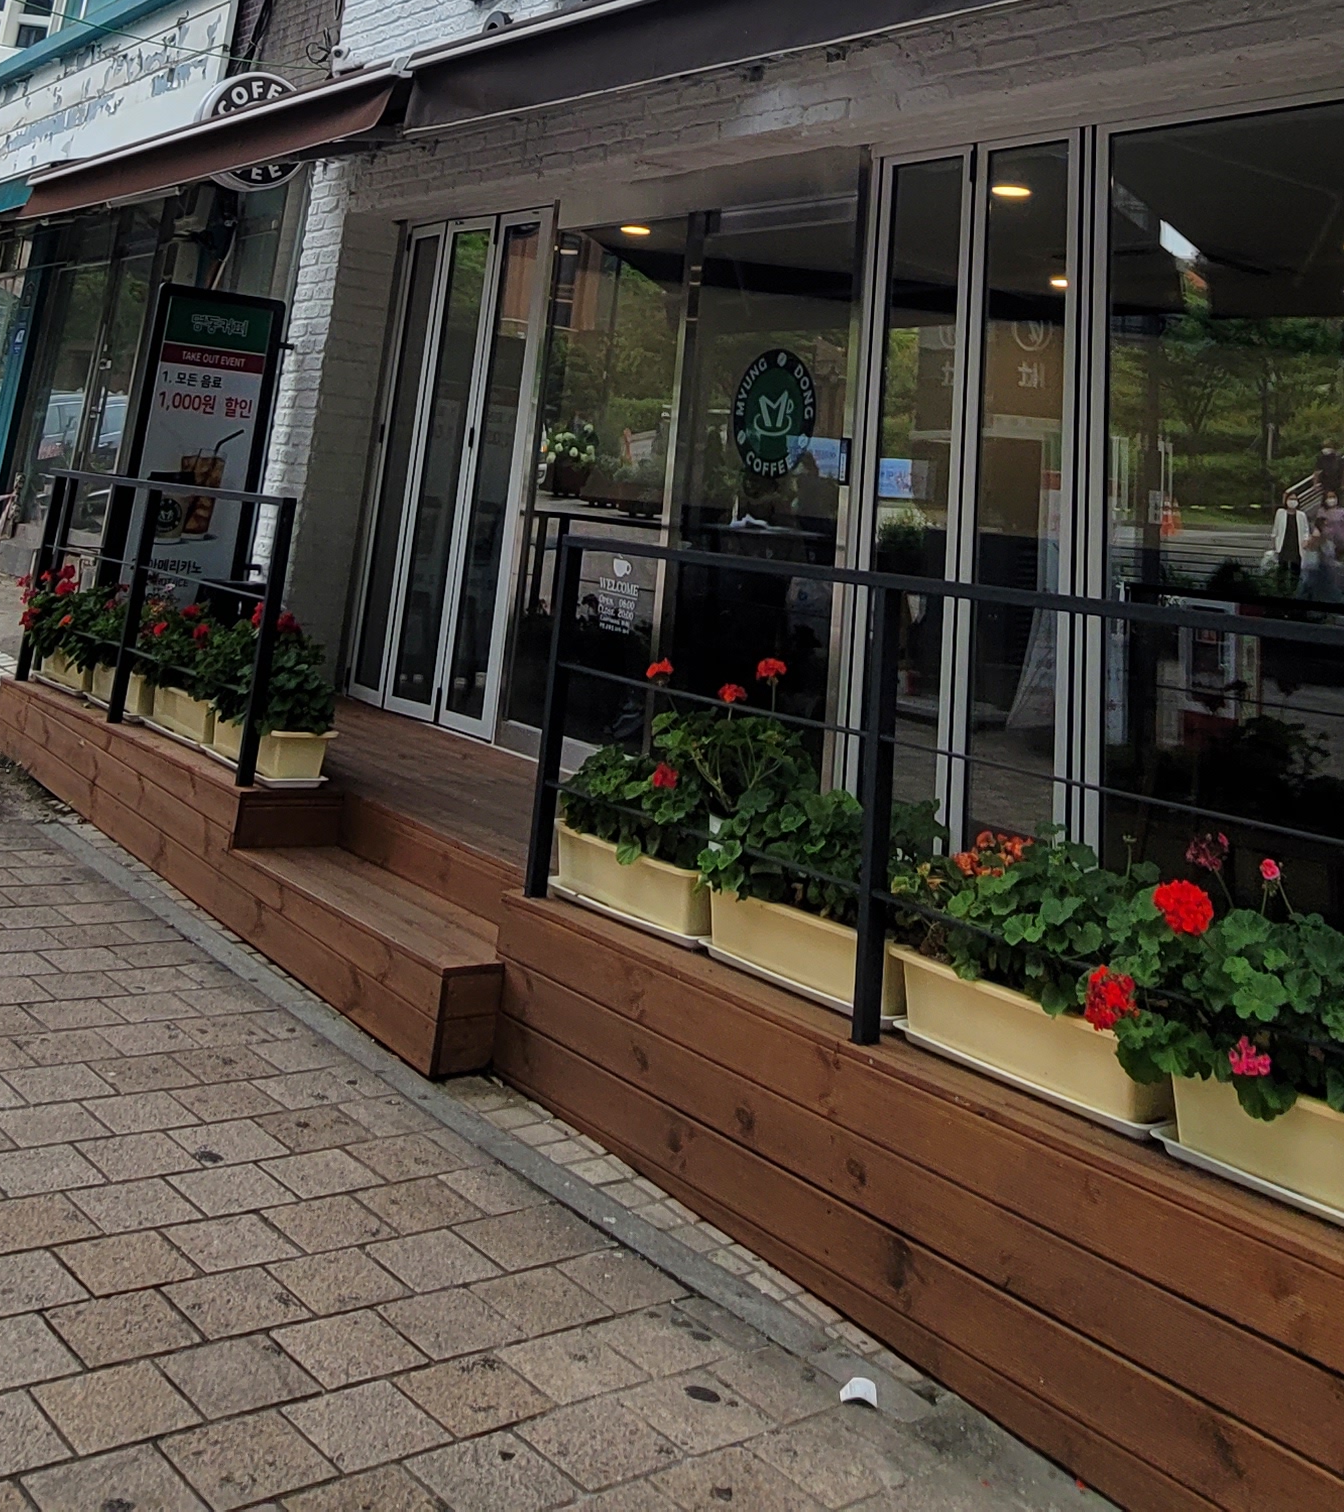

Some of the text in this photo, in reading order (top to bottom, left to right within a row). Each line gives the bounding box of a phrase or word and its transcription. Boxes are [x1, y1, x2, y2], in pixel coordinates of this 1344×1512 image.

[181, 350, 246, 369] TAKE OUT EVENT
[174, 371, 200, 388] 모든
[200, 374, 223, 389] 음료
[735, 357, 814, 420] MYUNG DONG
[158, 390, 254, 420] 1,000원 할인
[745, 452, 794, 478] COFFEE
[598, 576, 640, 597] WELCOME
